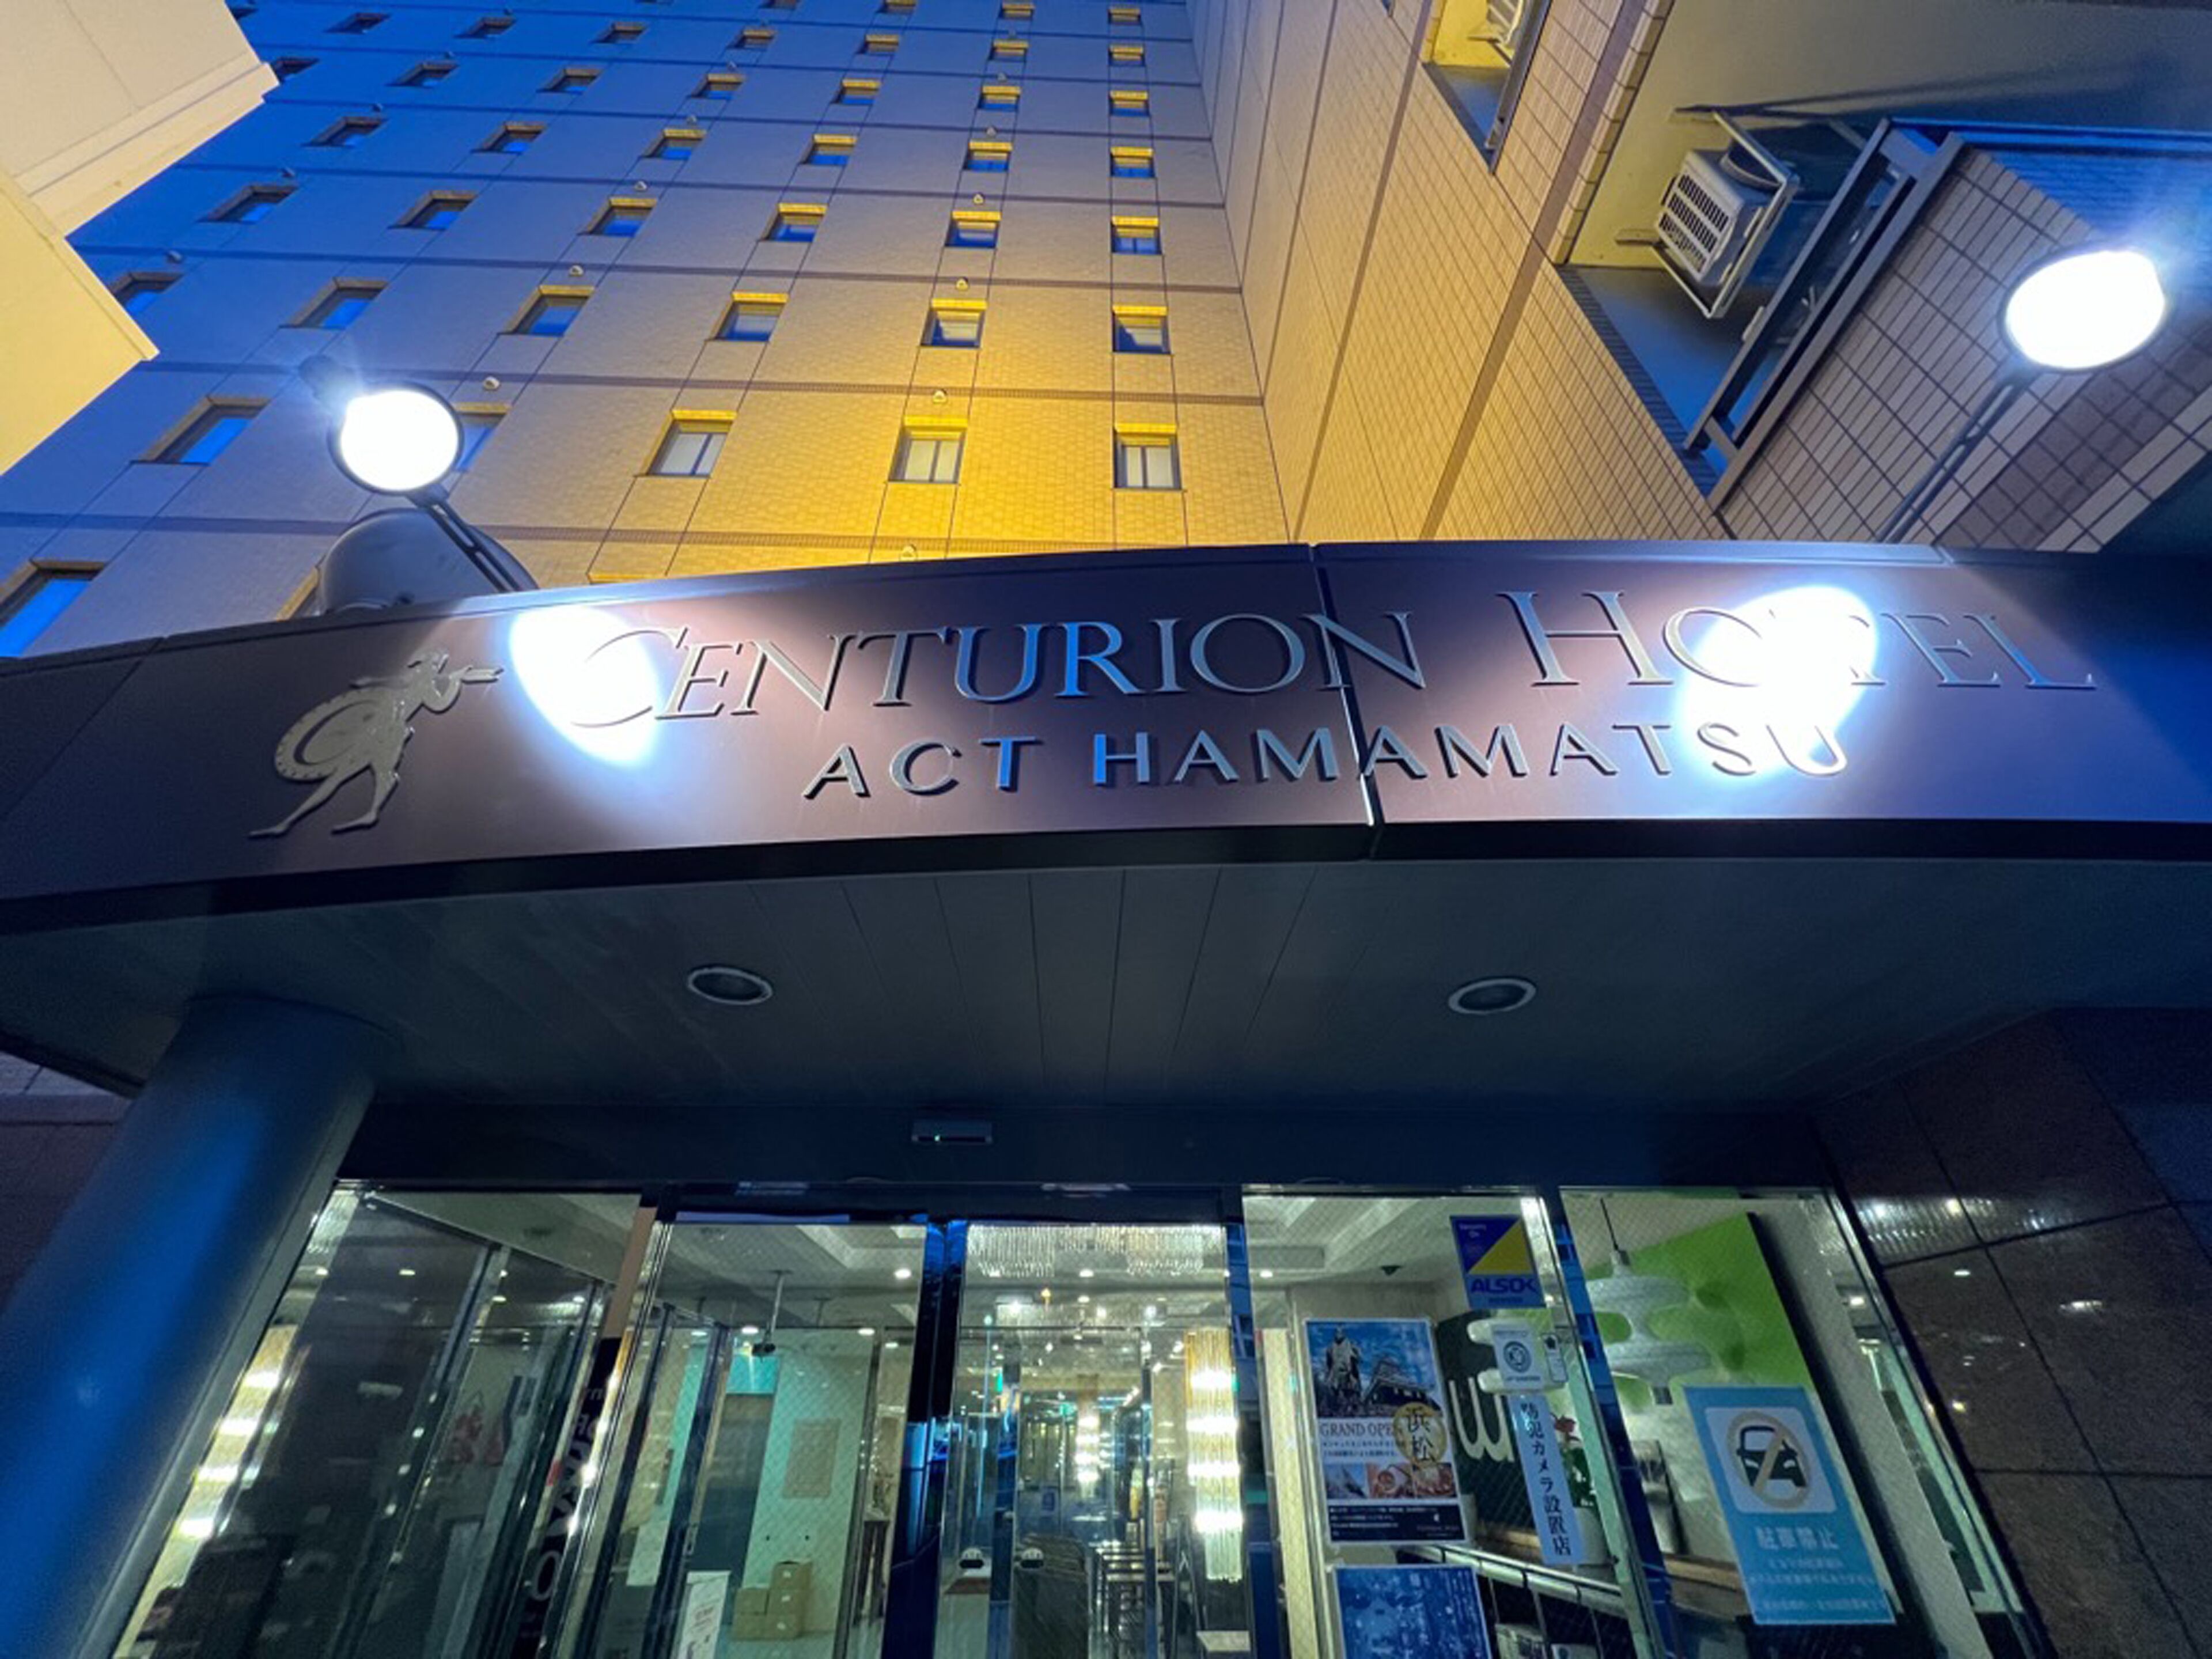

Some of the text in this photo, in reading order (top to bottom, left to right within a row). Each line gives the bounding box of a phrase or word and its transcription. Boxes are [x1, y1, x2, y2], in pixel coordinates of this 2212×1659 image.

[569, 611, 1426, 729] CENTURION
[804, 722, 1847, 800] ACT HAMAMATSU
[1471, 1277, 1539, 1294] ALSOK
[1320, 1422, 1366, 1437] GRAND
[1407, 1409, 1438, 1463] 浜松
